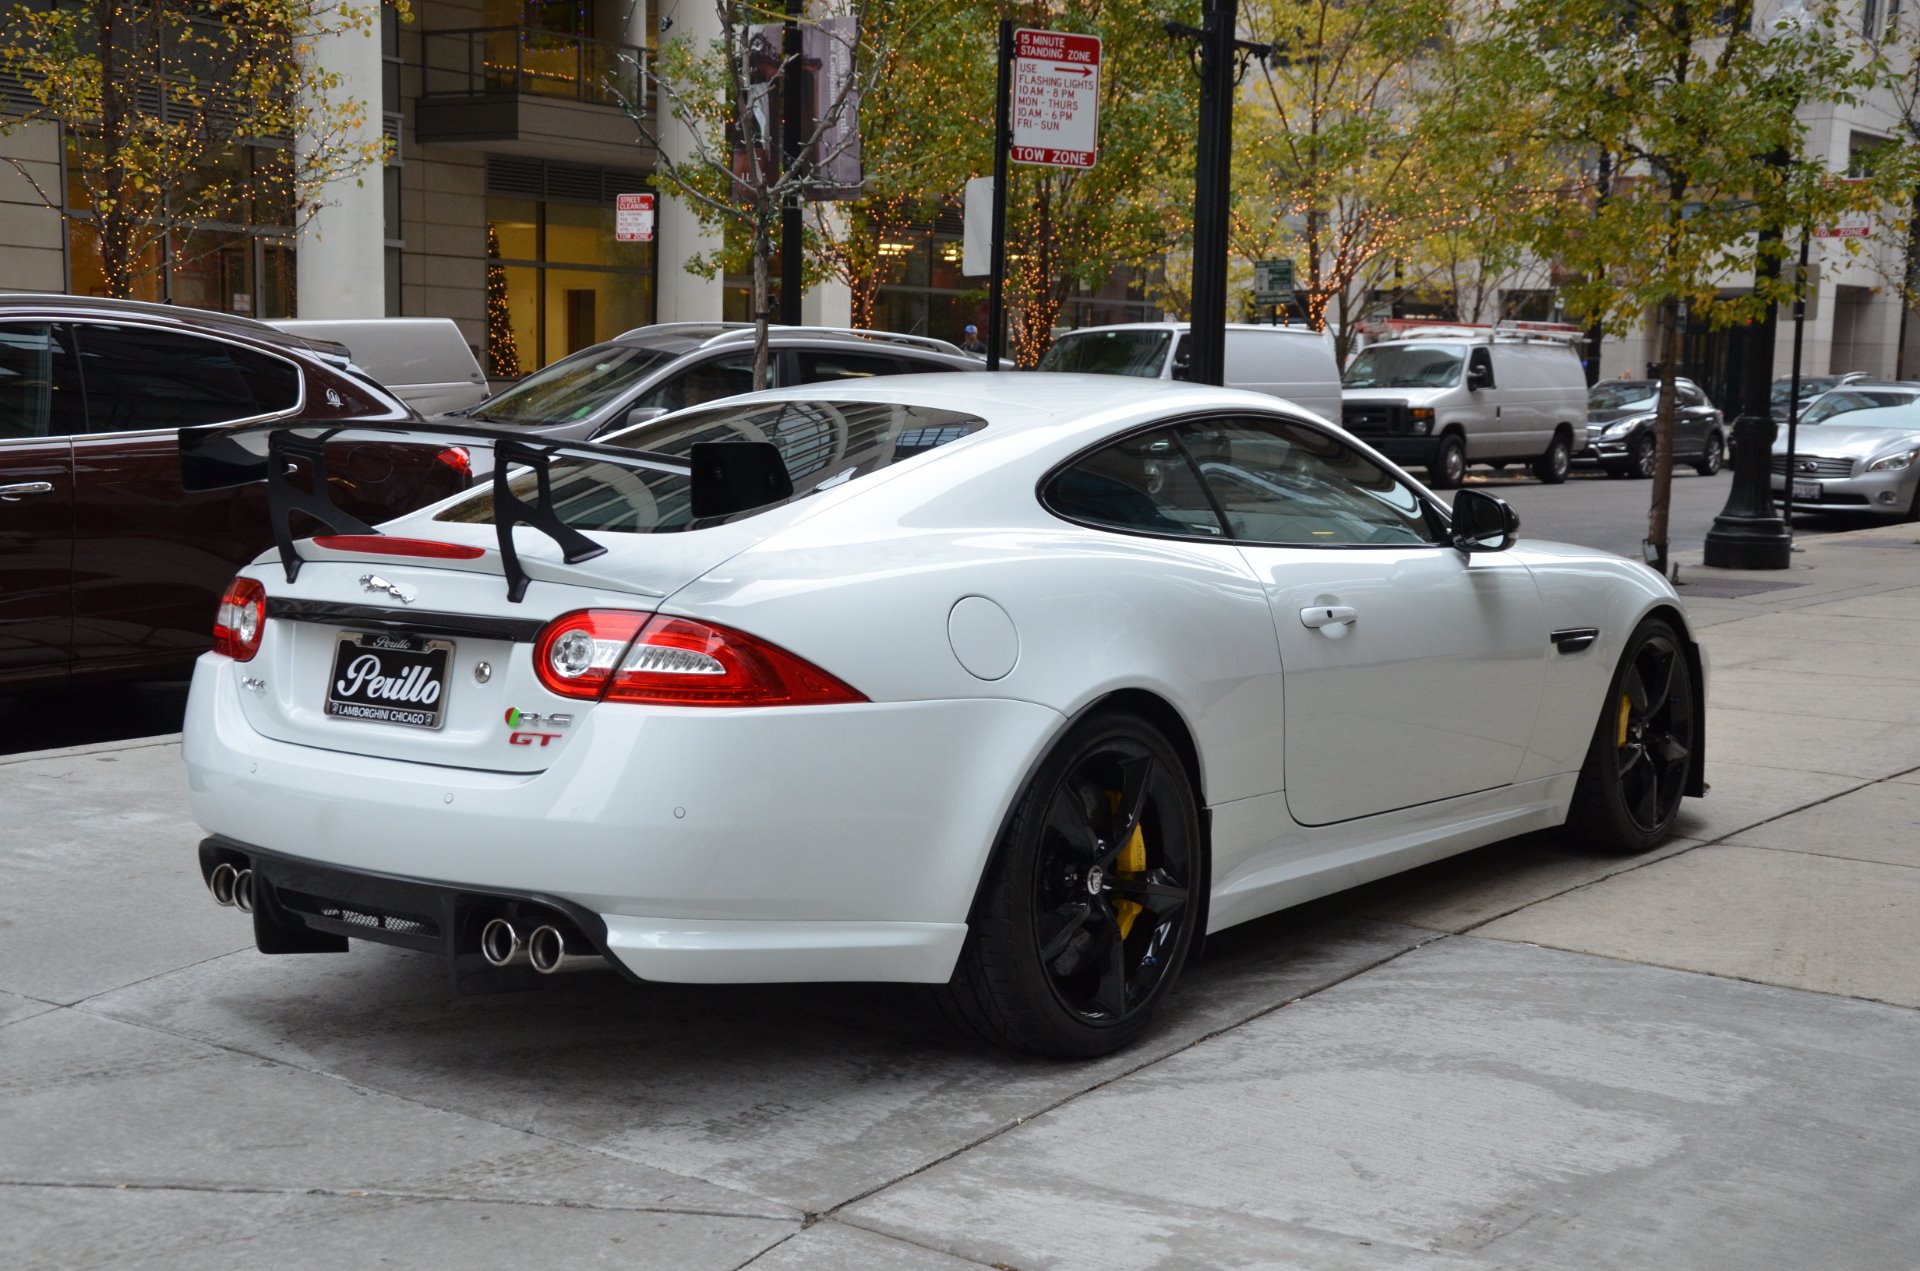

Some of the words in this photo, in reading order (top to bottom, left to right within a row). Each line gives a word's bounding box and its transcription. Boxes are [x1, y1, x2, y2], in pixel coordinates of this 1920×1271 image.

[1020, 33, 1030, 44] 15
[1032, 34, 1065, 48] MINUTE
[1020, 45, 1063, 59] STANDING
[1067, 50, 1091, 62] ZONE
[1019, 63, 1037, 73] USE
[1018, 74, 1062, 87] FLASHING
[1063, 79, 1094, 90] LIGHTS
[1052, 88, 1059, 98] 8
[1061, 89, 1075, 99] PM
[1018, 97, 1038, 106] MON
[1048, 99, 1079, 111] THURS
[1051, 111, 1058, 120] 6
[1059, 111, 1073, 121] PM
[1017, 118, 1032, 128] FRI
[1040, 120, 1060, 131] SUN
[1016, 147, 1046, 161] TOW
[1051, 150, 1089, 165] ZONE
[1839, 228, 1863, 237] ZONE
[372, 634, 412, 650] Perillo
[337, 654, 441, 704] Perillo
[338, 704, 388, 721] LAMBORGHINI
[390, 710, 425, 724] CHICAGO
[508, 731, 562, 748] GT
